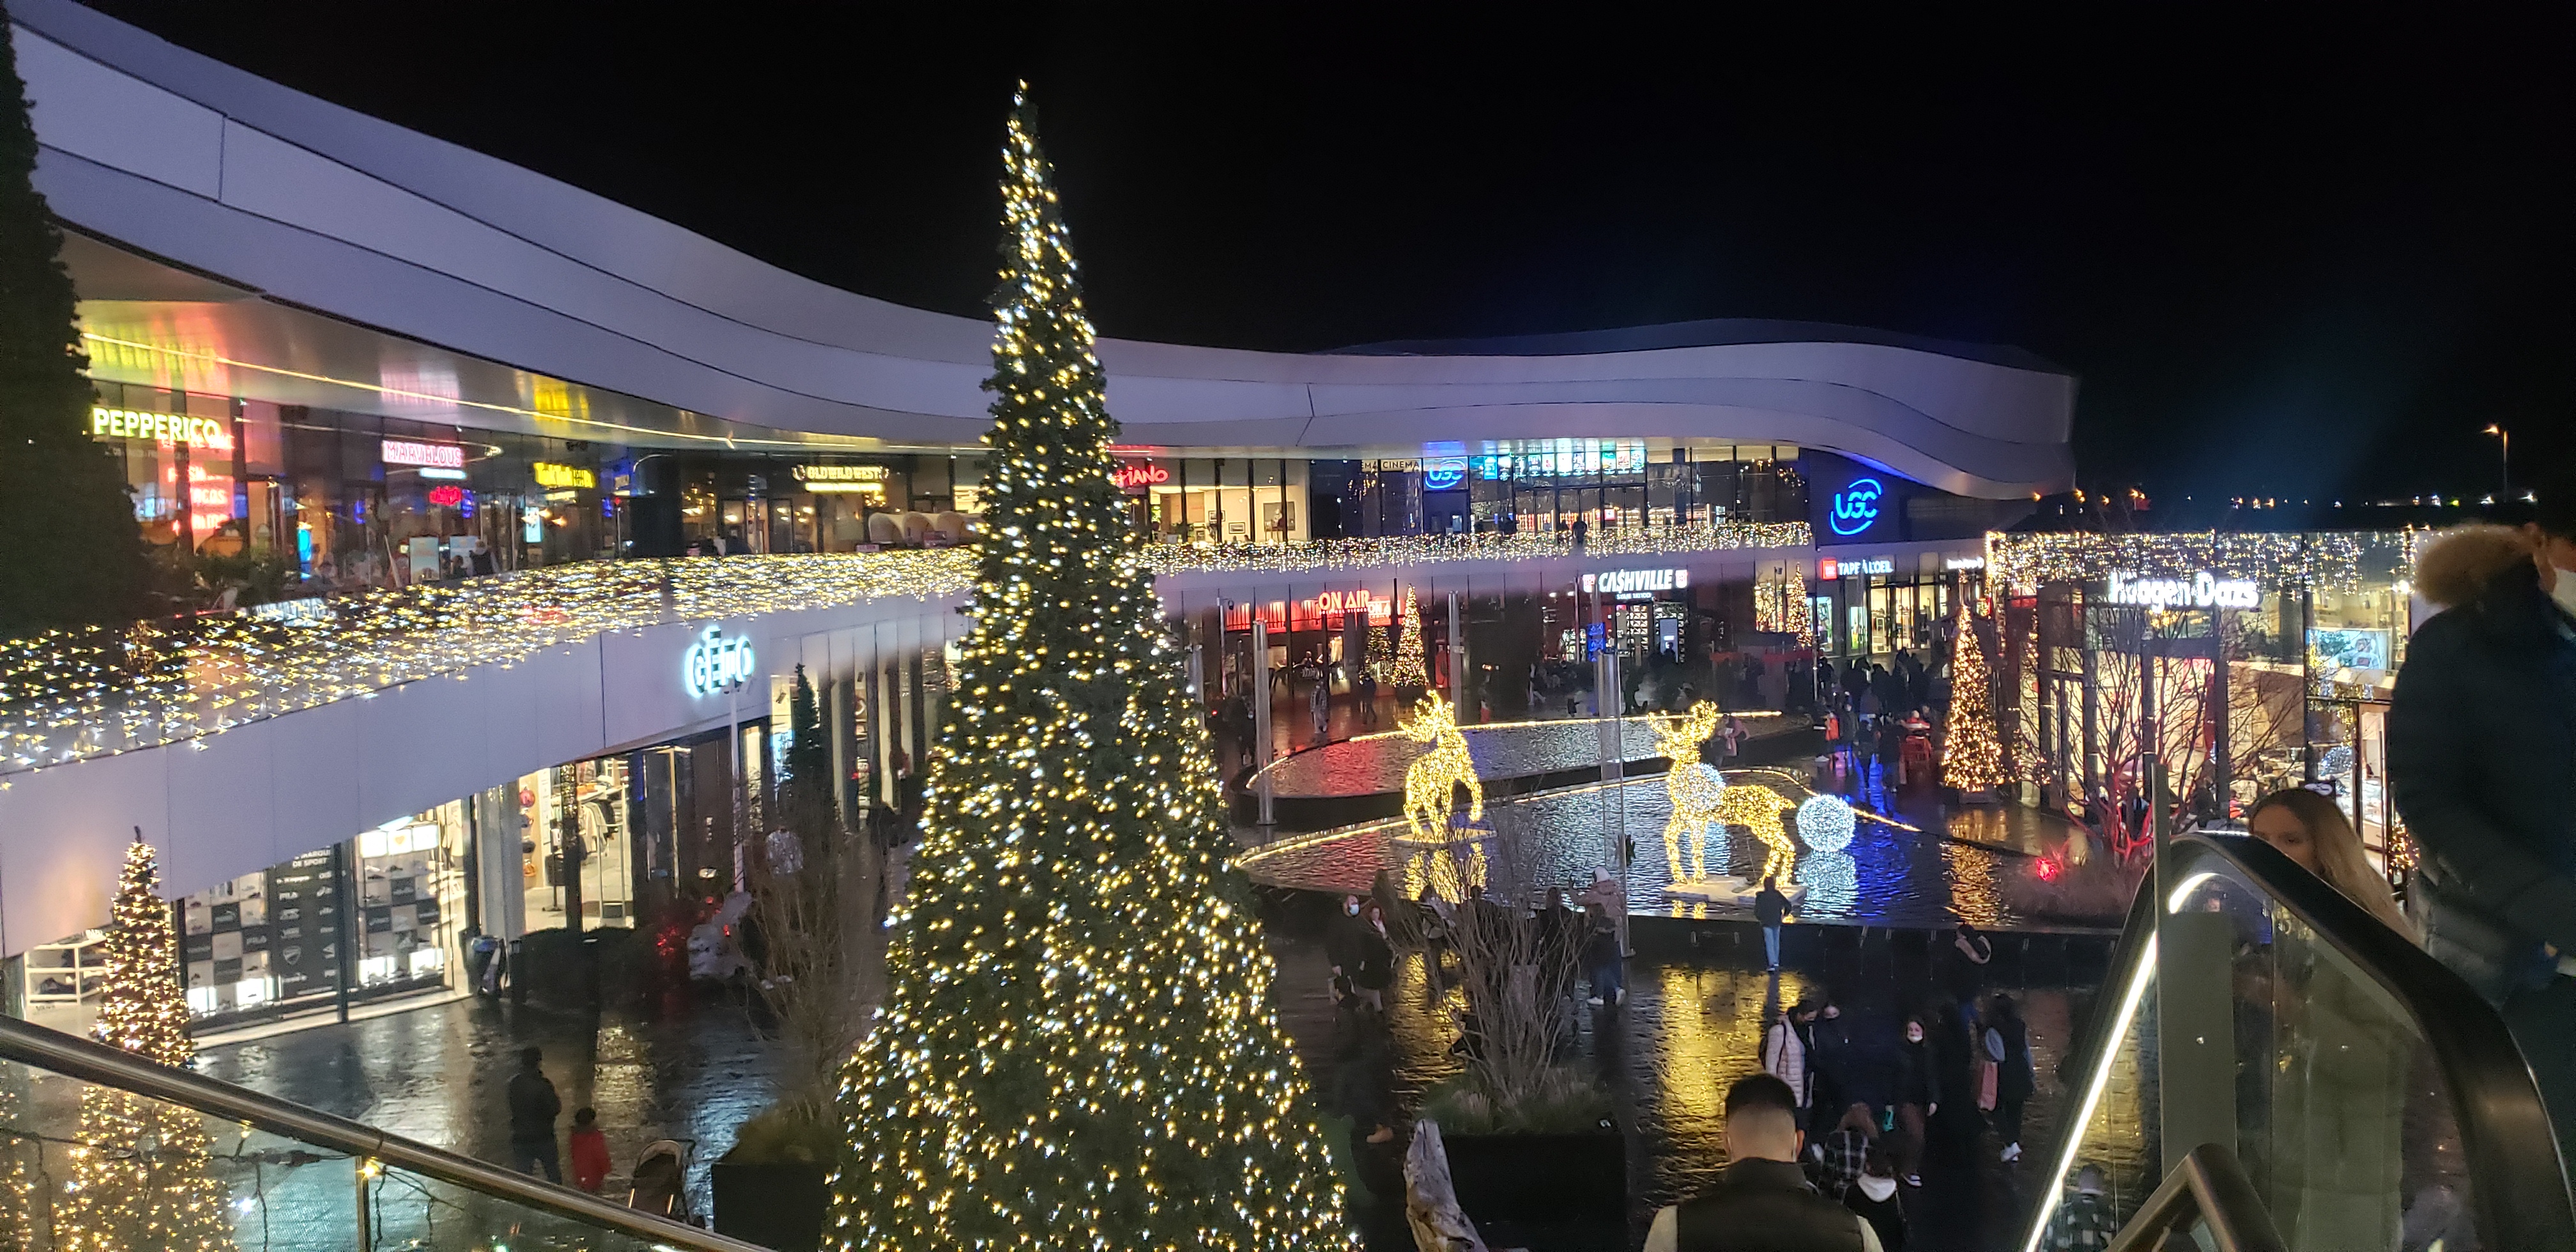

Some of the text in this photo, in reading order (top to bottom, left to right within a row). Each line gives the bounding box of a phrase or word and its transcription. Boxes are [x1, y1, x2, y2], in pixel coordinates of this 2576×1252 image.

[92, 406, 223, 444] PEPPERICO
[382, 440, 463, 467] MARVELOUS
[806, 466, 881, 479] OLD WILD WEST
[1383, 461, 1420, 469] CINEMA
[1318, 591, 1342, 610] ON
[1344, 589, 1370, 609] AIR
